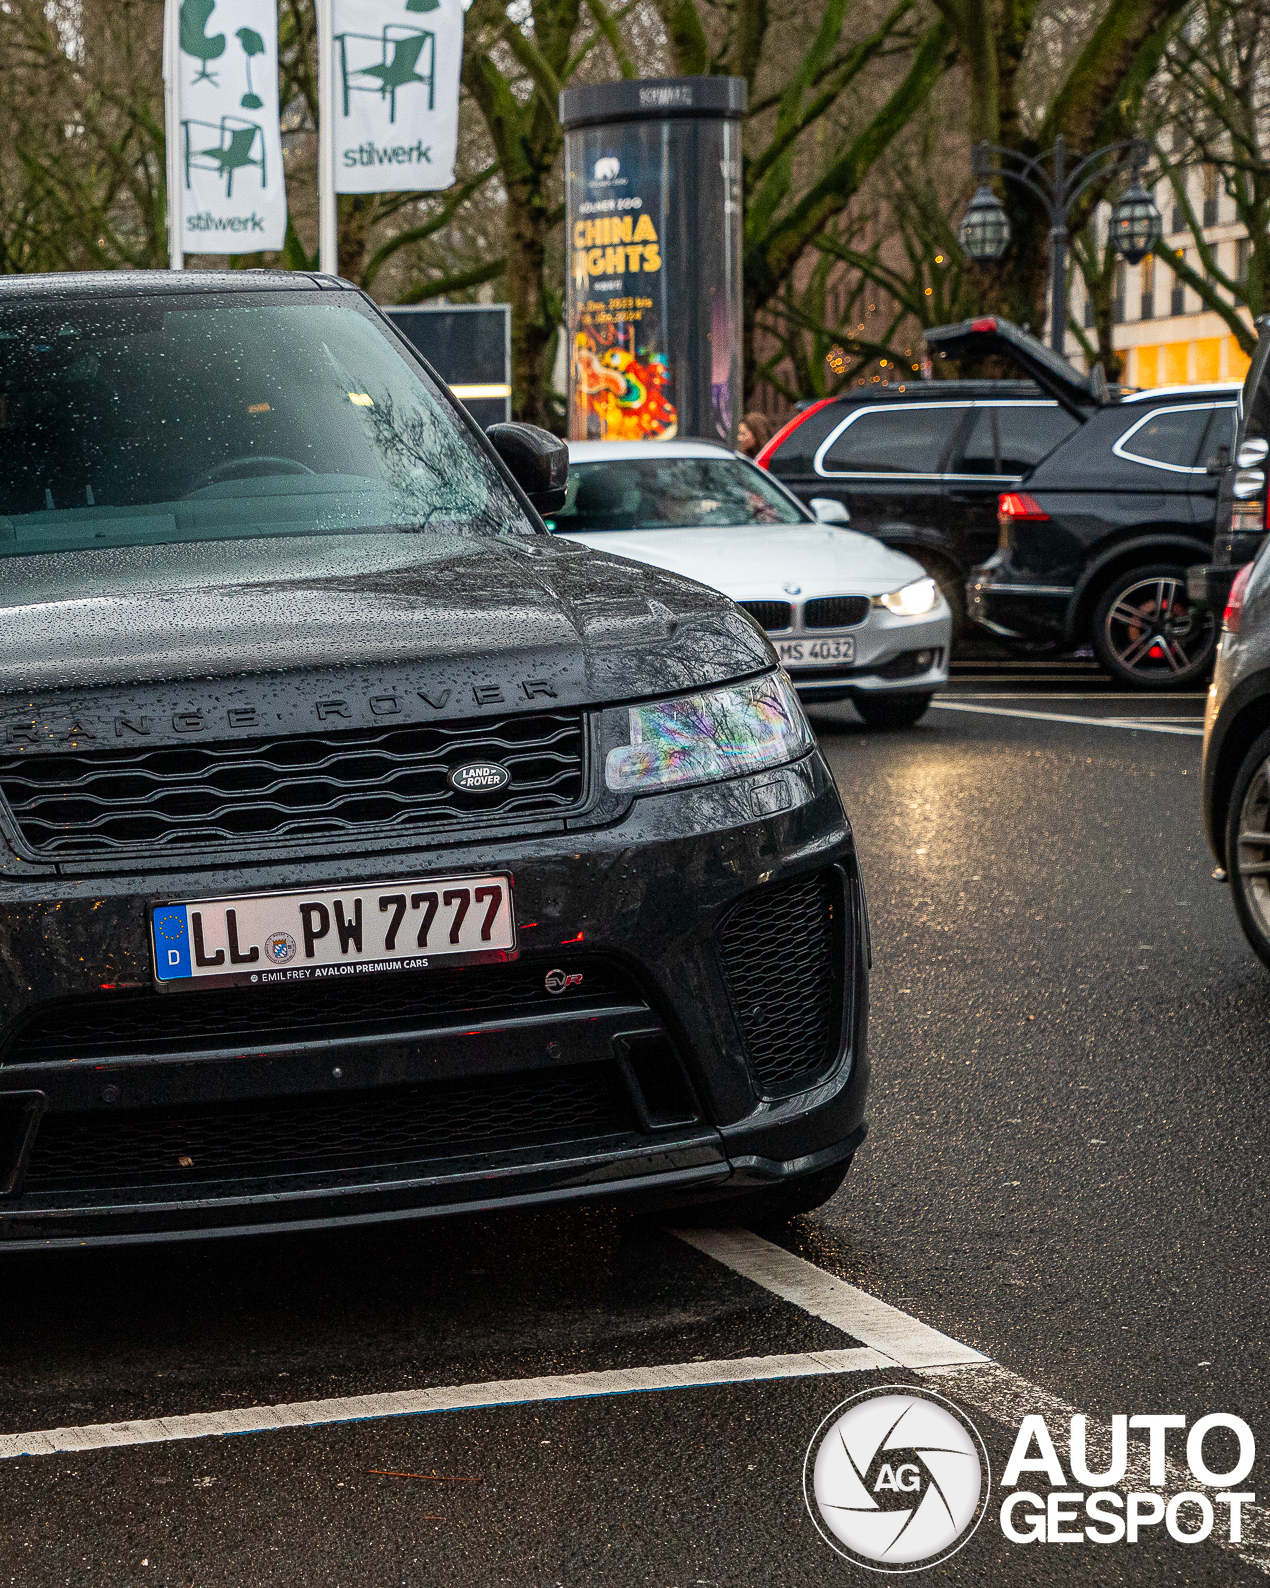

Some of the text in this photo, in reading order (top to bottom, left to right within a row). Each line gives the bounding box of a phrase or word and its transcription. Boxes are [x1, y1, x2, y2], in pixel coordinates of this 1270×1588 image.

[343, 139, 432, 167] stilwerk
[186, 212, 265, 233] stilwerk
[574, 214, 658, 248] CHINA
[780, 641, 853, 660] MS 4032
[6, 679, 559, 744] RANGE ROVER
[462, 767, 490, 779] LAND
[466, 775, 501, 787] ROVER
[191, 907, 259, 967] LL
[299, 897, 363, 958] PW
[378, 884, 503, 950] 7777
[168, 949, 181, 966] D
[262, 958, 429, 982] EMIL FREY AVALON PREMIUM CARS
